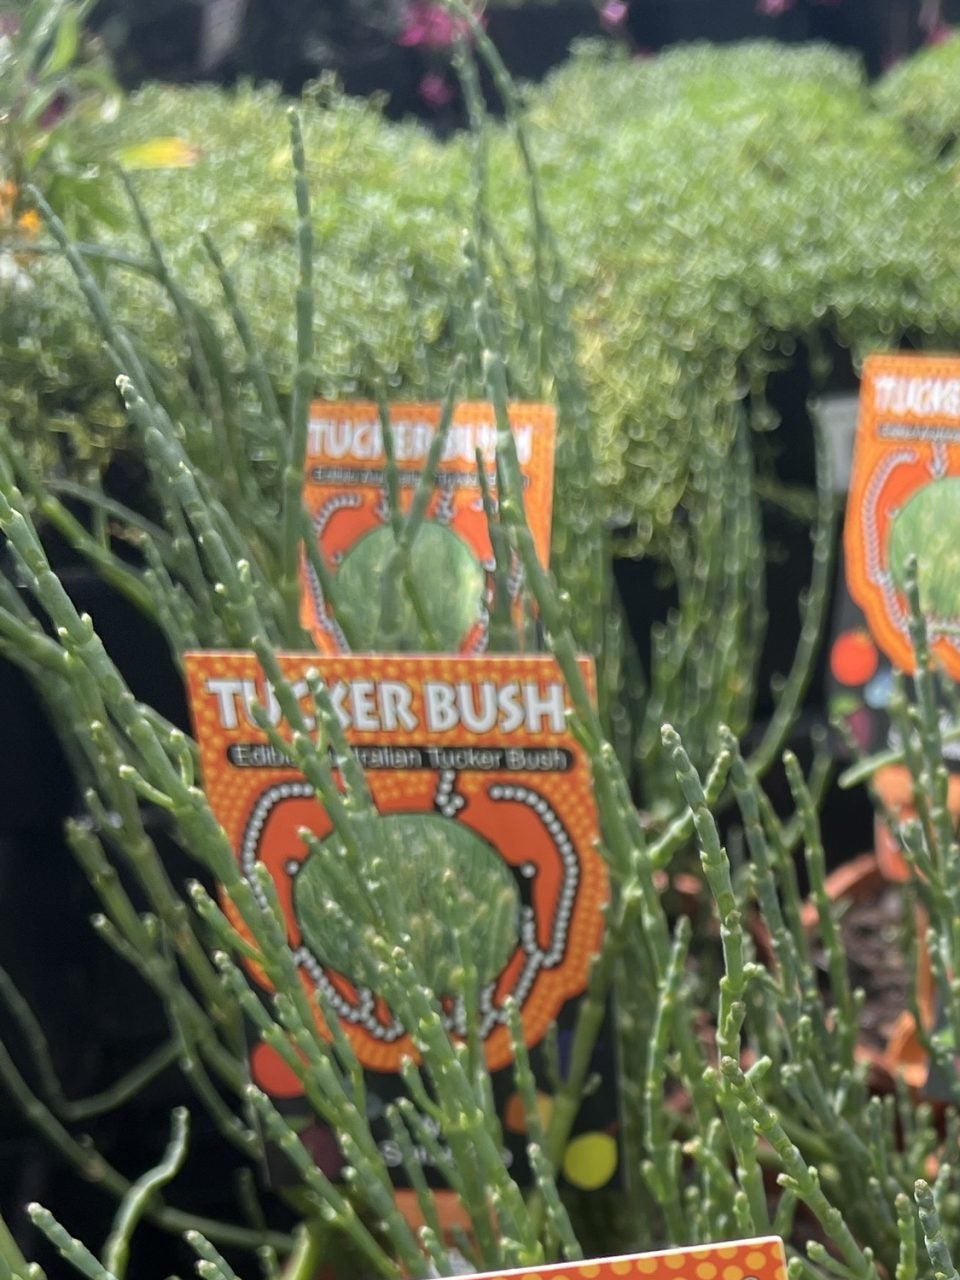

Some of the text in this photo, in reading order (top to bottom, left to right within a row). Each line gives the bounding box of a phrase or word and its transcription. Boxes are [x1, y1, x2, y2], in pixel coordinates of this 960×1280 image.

[424, 680, 568, 734] BUSH
[428, 746, 503, 770] Tucker
[505, 747, 568, 771] Bush
